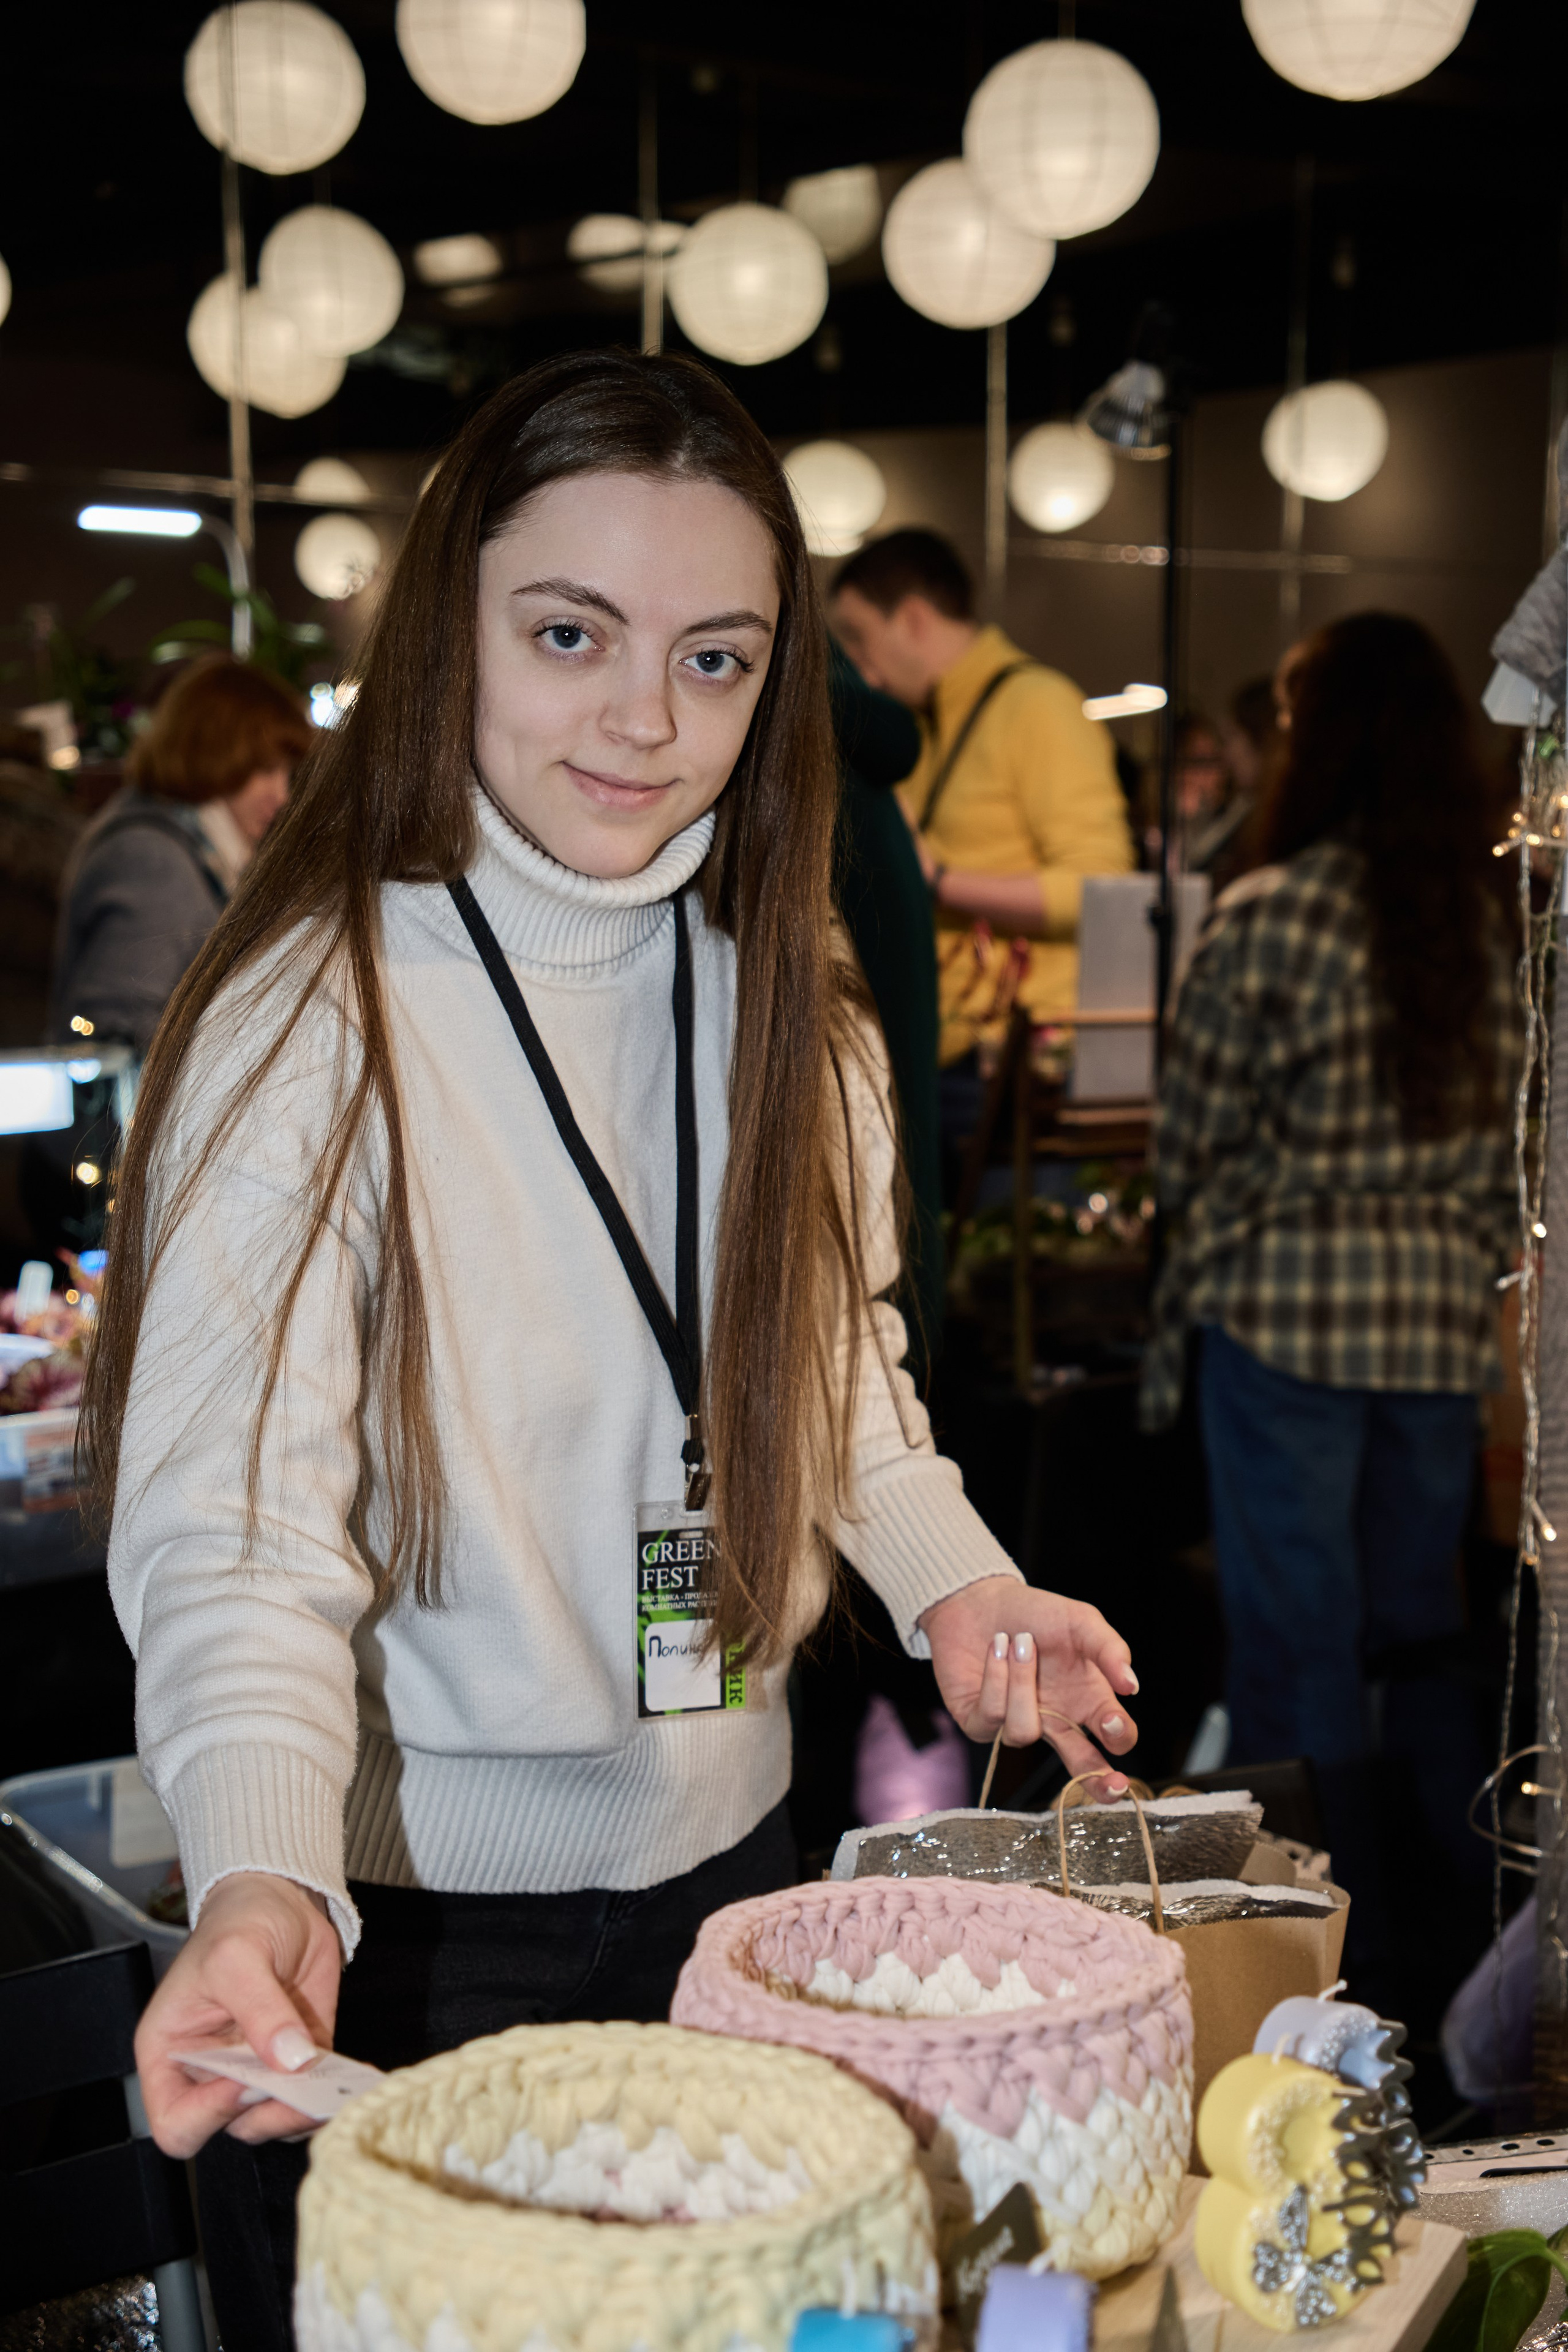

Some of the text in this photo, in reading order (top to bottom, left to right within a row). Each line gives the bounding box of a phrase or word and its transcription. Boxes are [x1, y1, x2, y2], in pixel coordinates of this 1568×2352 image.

[642, 1539, 722, 1563] GREEN
[642, 1566, 698, 1590] FEST
[642, 1594, 680, 1603] ВЫСТАВКА
